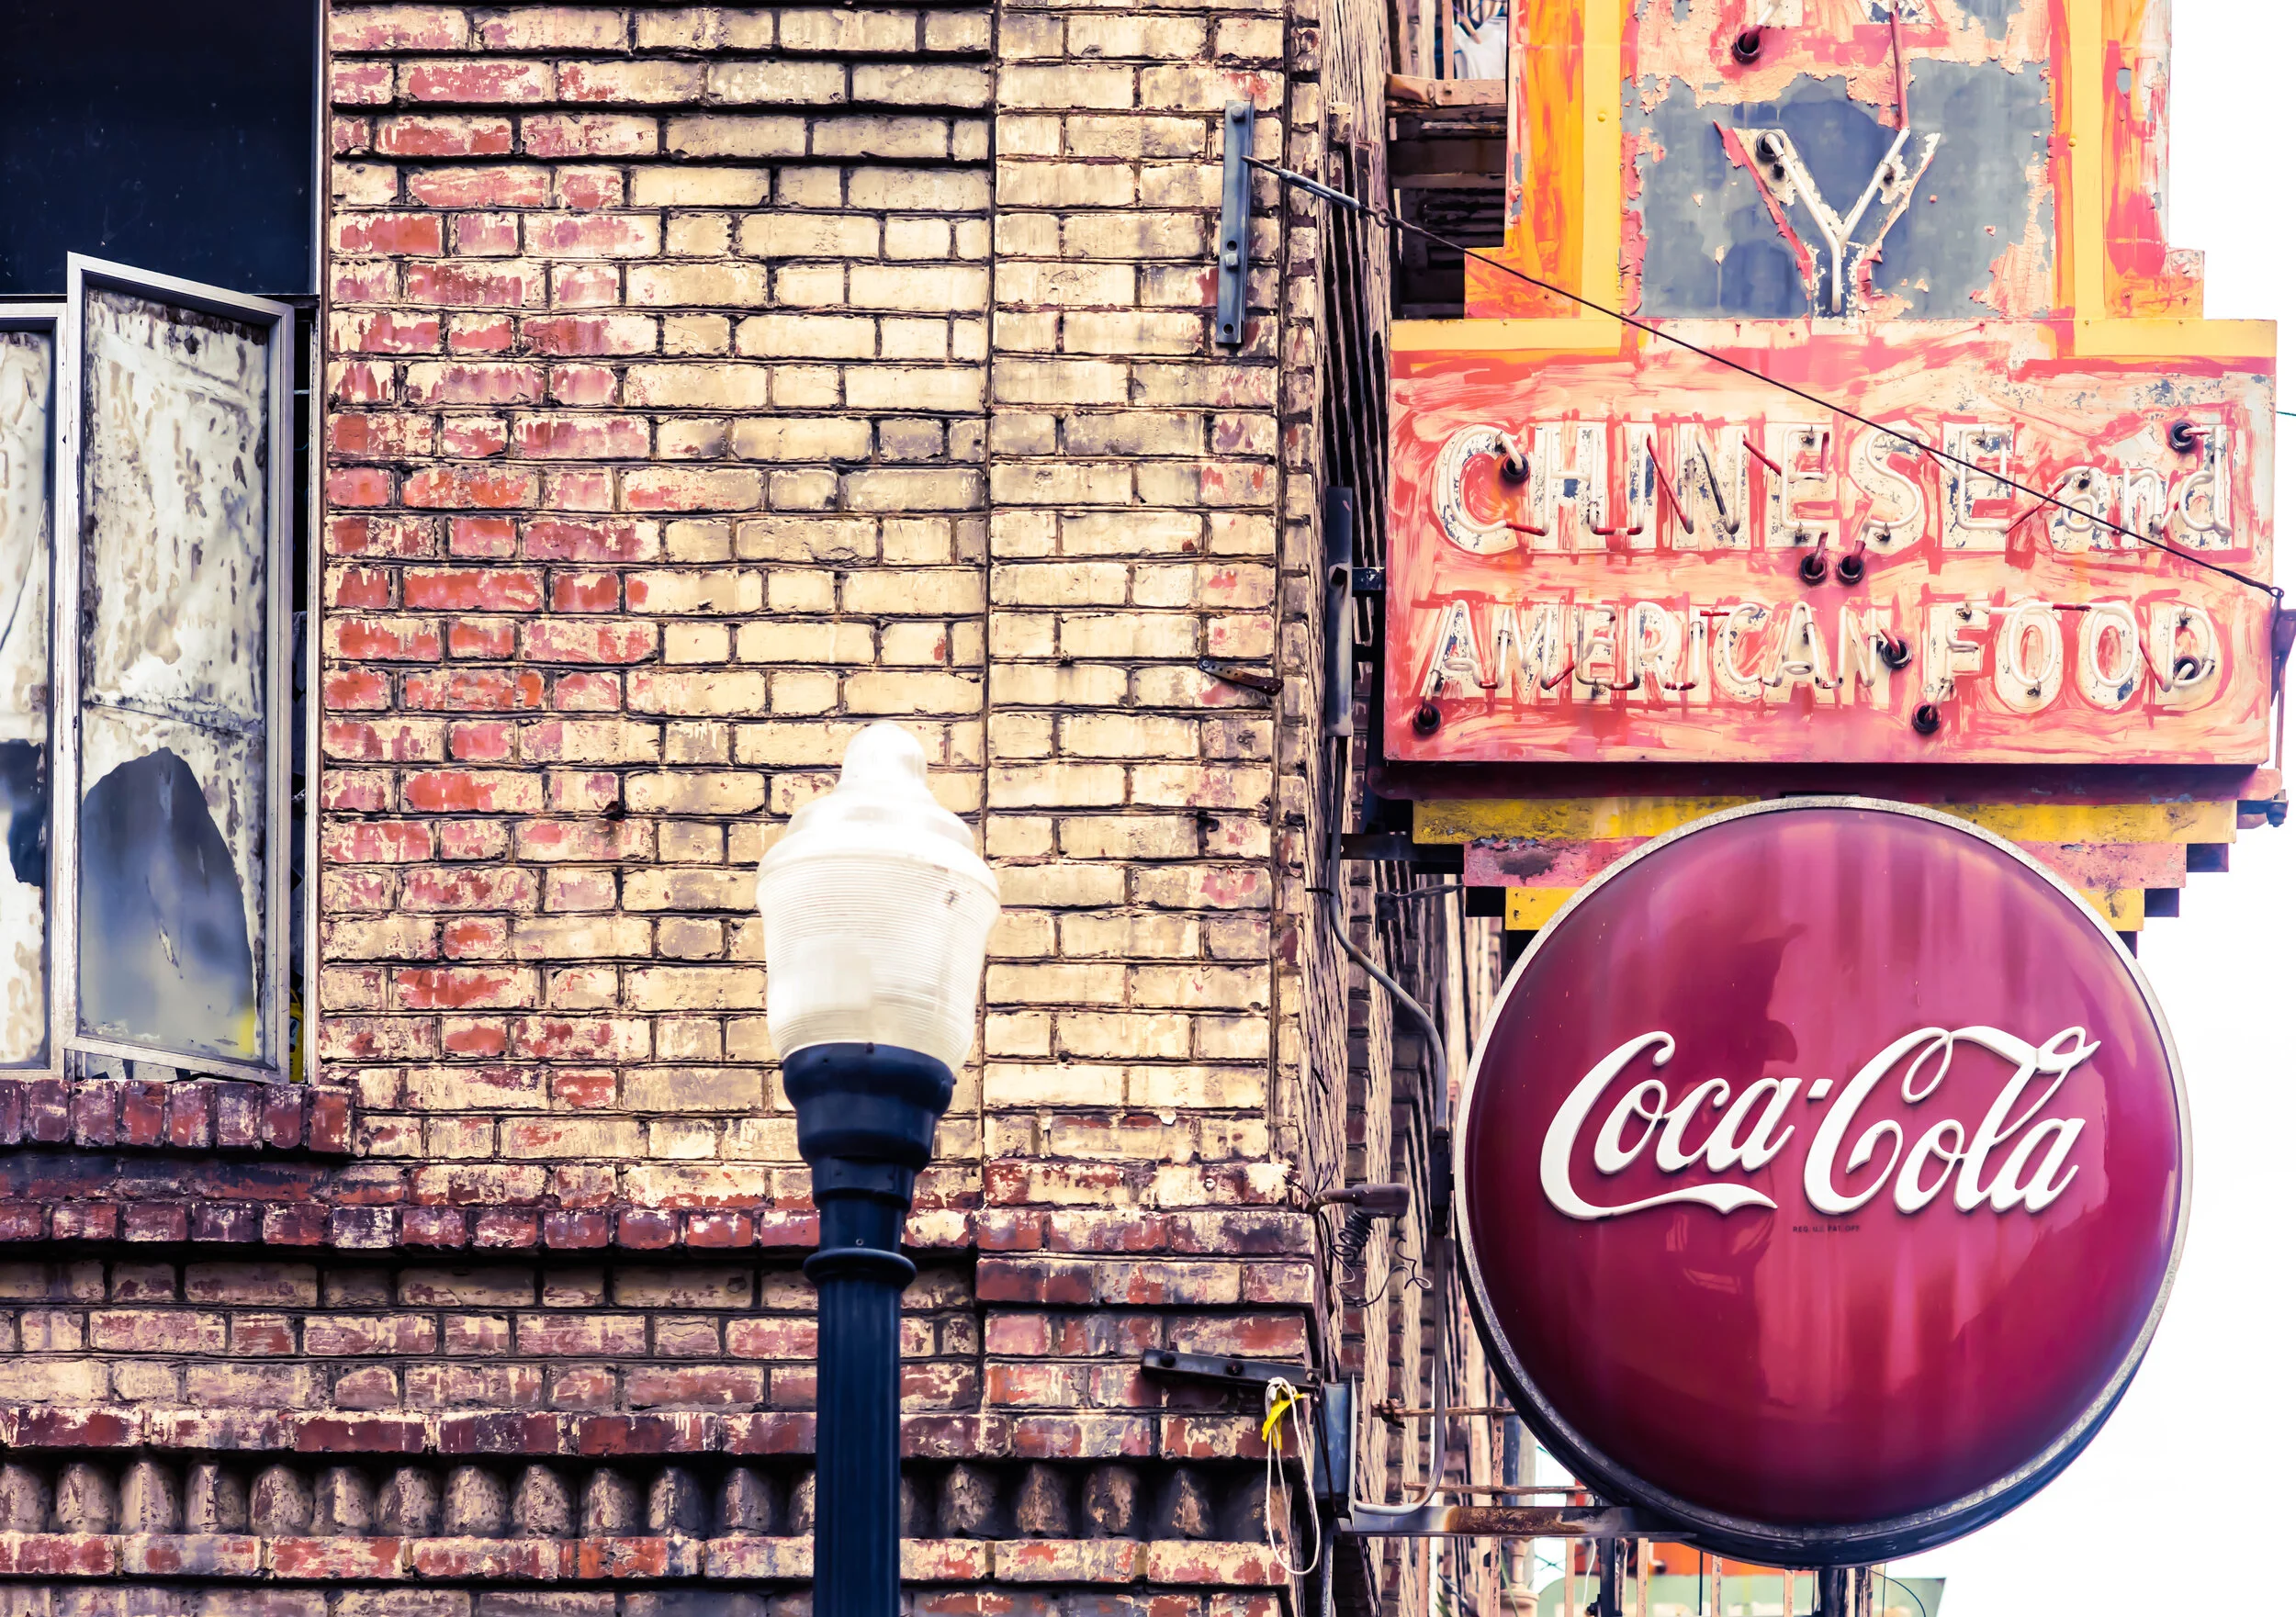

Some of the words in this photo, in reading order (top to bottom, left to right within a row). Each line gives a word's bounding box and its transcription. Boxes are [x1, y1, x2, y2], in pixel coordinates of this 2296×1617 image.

[1435, 420, 2016, 555] CHINESE
[2047, 423, 2234, 554] and
[1418, 600, 1891, 705] AMERICAN
[1925, 599, 2223, 713] FOOD
[1539, 1025, 2102, 1221] Coca-Cola
